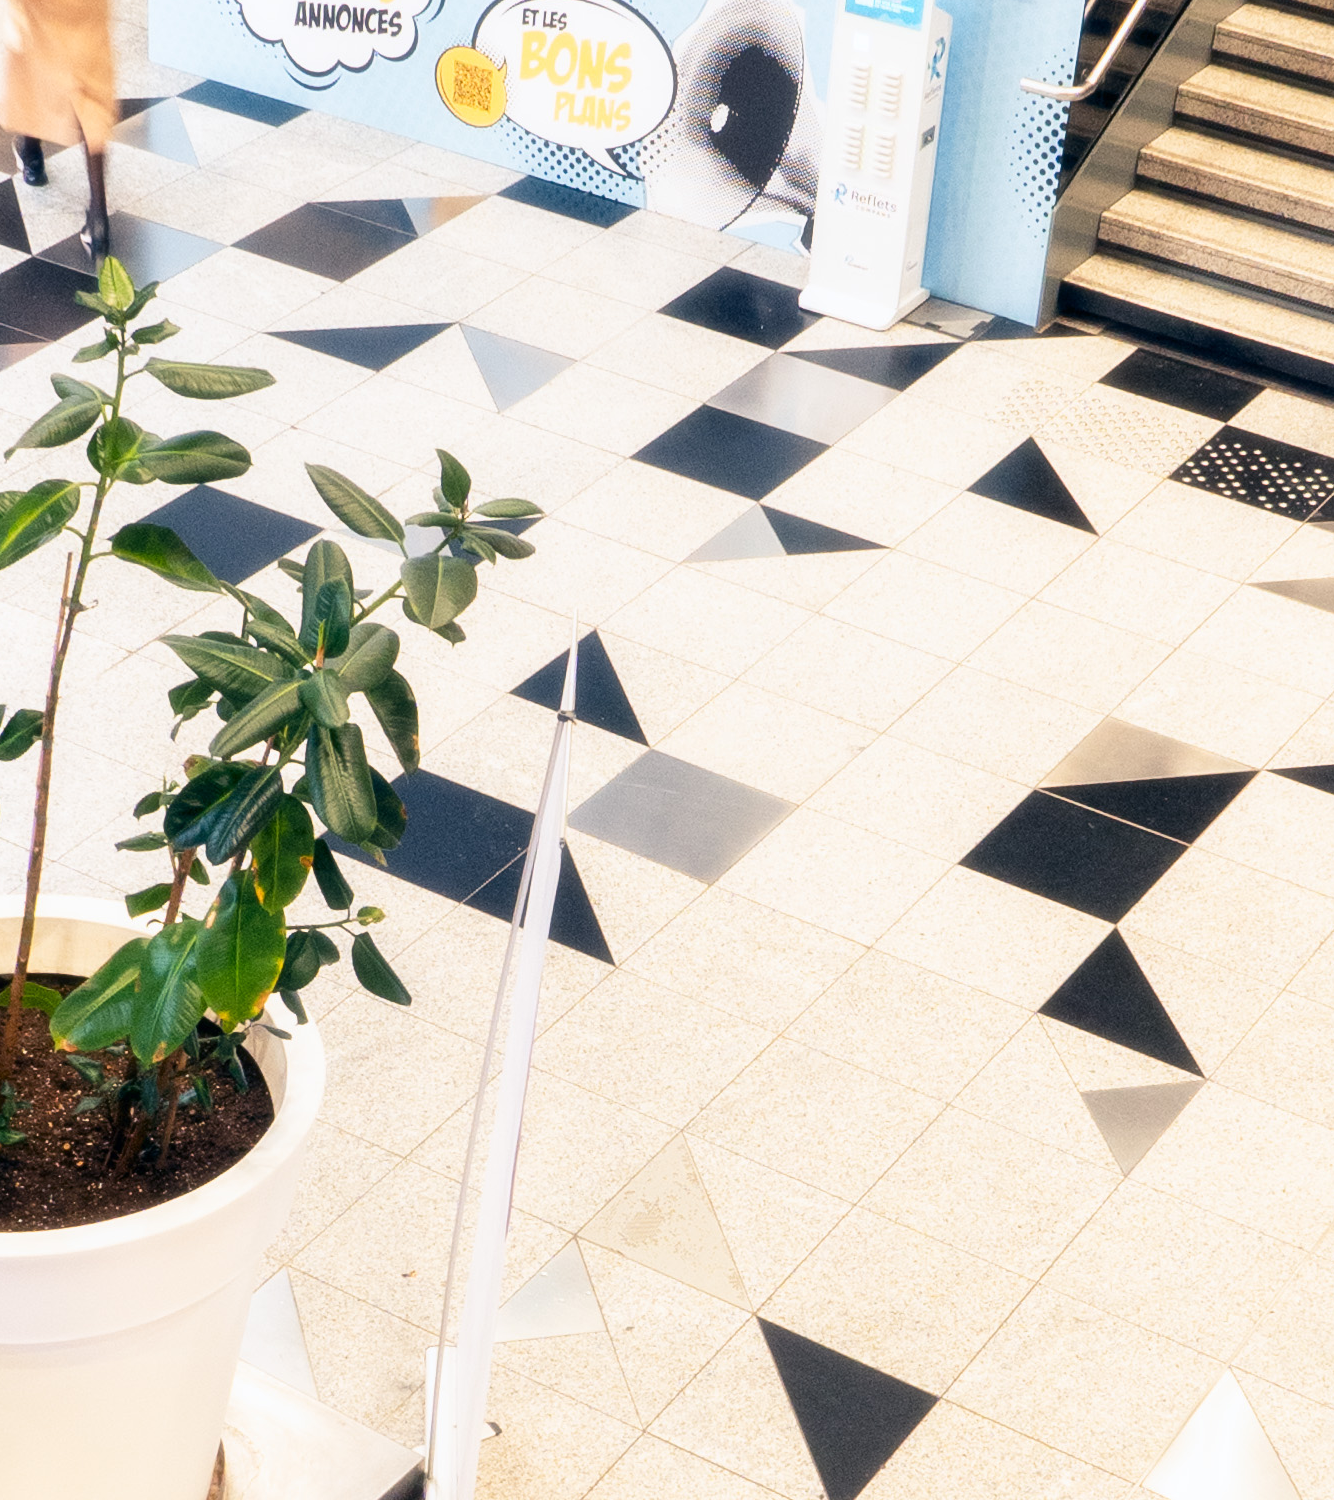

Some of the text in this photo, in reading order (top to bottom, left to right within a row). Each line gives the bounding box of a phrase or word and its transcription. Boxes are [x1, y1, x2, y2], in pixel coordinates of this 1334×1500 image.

[293, 2, 403, 38] ANNONCES
[520, 7, 568, 31] ET LES
[518, 28, 633, 92] BONS
[552, 94, 632, 131] PLANS
[850, 189, 898, 213] Reflets
